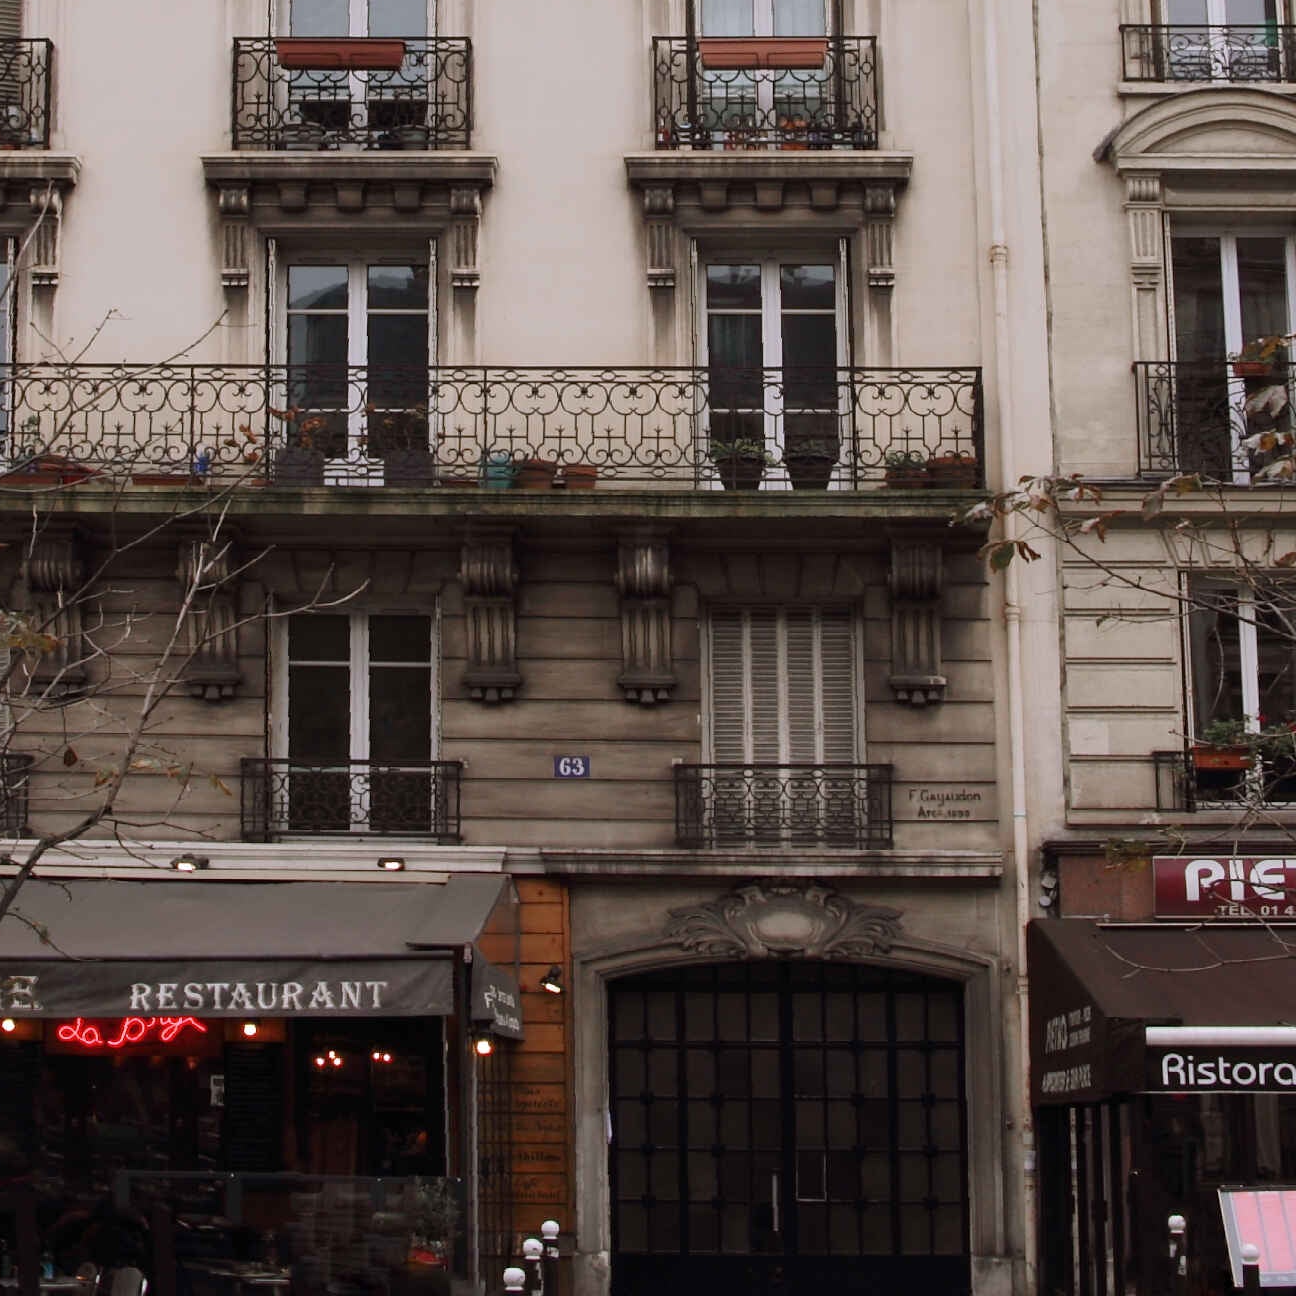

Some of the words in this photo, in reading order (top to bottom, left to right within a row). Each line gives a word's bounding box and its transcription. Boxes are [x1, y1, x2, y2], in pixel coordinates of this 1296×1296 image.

[559, 757, 585, 776] 63
[1260, 905, 1278, 916] 01
[129, 981, 389, 1011] RESTAURANT
